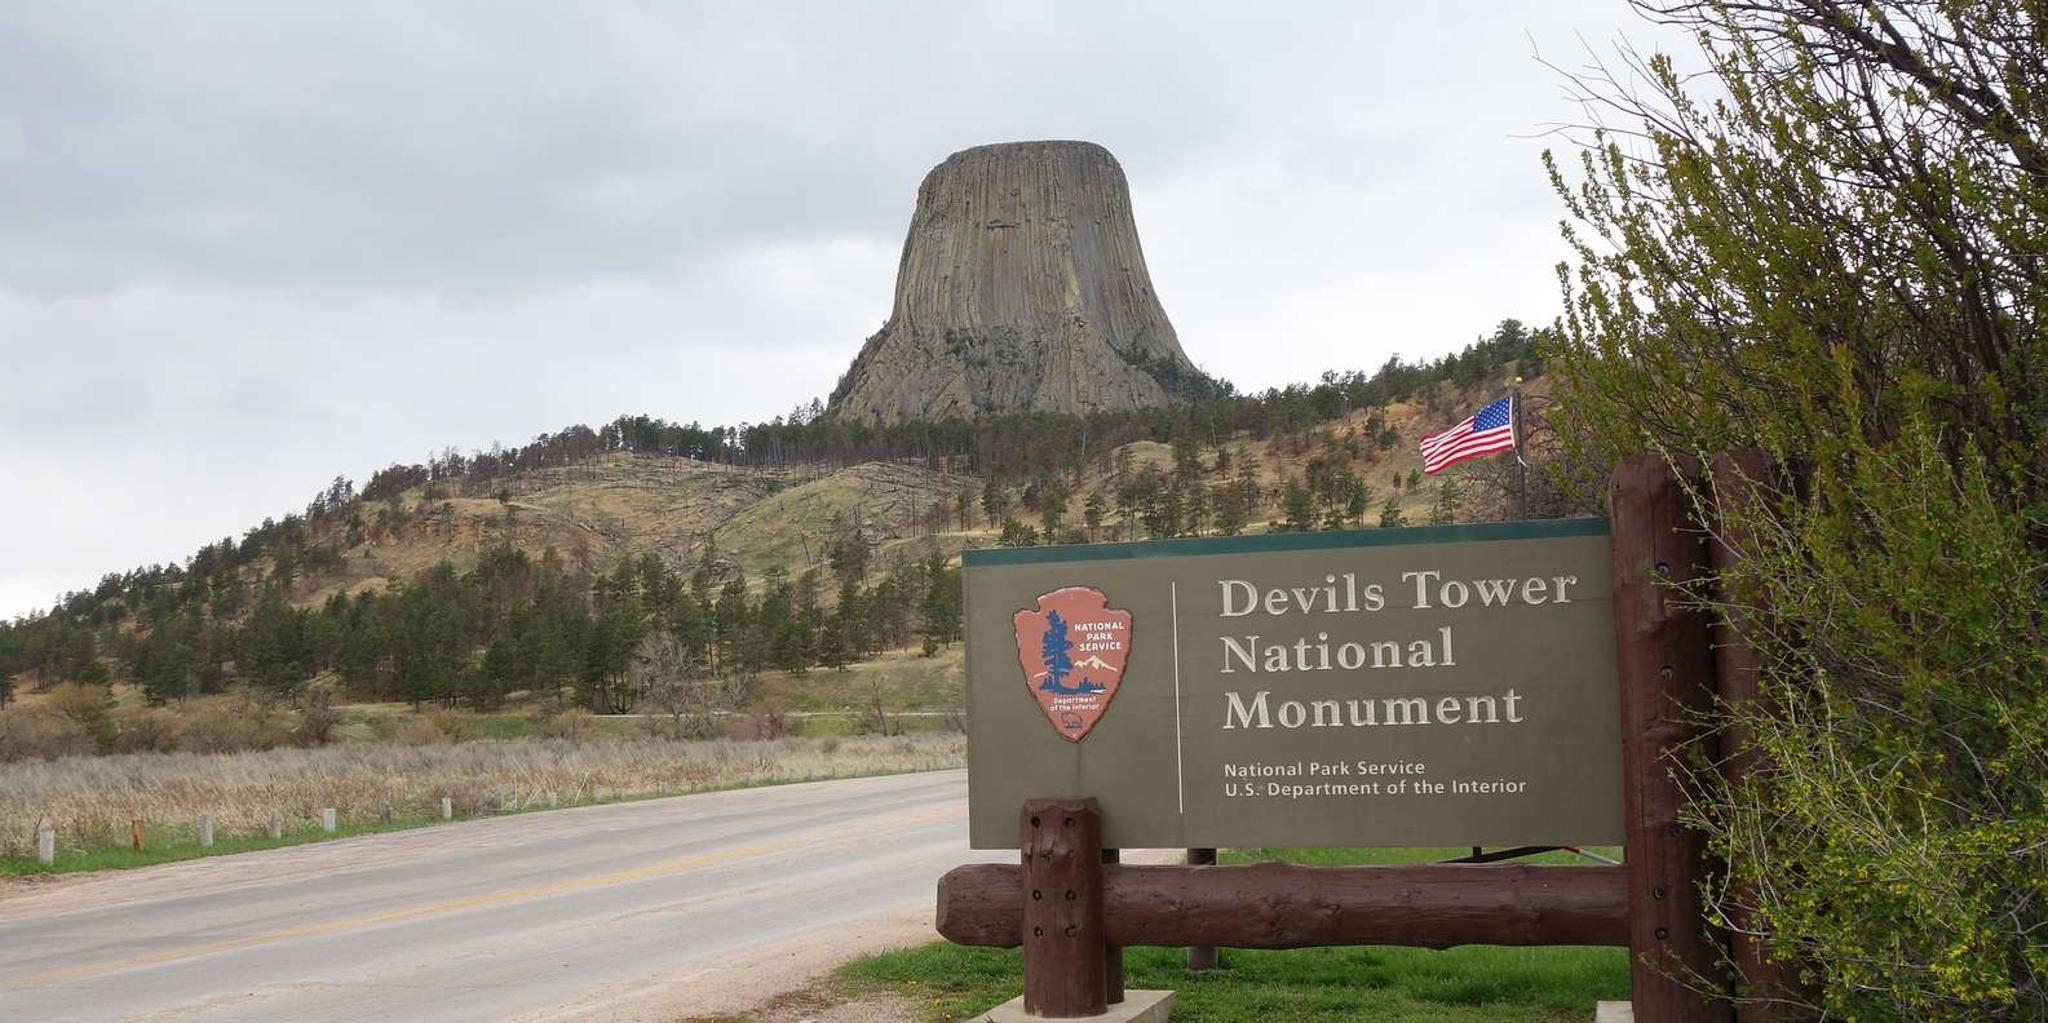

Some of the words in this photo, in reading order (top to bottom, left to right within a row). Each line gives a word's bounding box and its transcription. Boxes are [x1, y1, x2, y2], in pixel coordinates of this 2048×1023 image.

[1218, 573, 1385, 617] Devils
[1402, 569, 1578, 609] Tower
[1074, 622, 1124, 631] NATIONAL
[1086, 632, 1113, 641] PARK
[1079, 642, 1122, 652] SERVICE
[1220, 626, 1456, 673] National
[1053, 696, 1097, 705] Department
[1222, 688, 1524, 730] Monument
[1224, 761, 1302, 778] National
[1309, 760, 1350, 776] Park
[1357, 759, 1426, 776] Service
[1225, 783, 1261, 797] U.S.
[1267, 780, 1380, 799] Department
[1388, 779, 1408, 795] of
[1413, 779, 1445, 794] the
[1451, 778, 1527, 795] Interior
